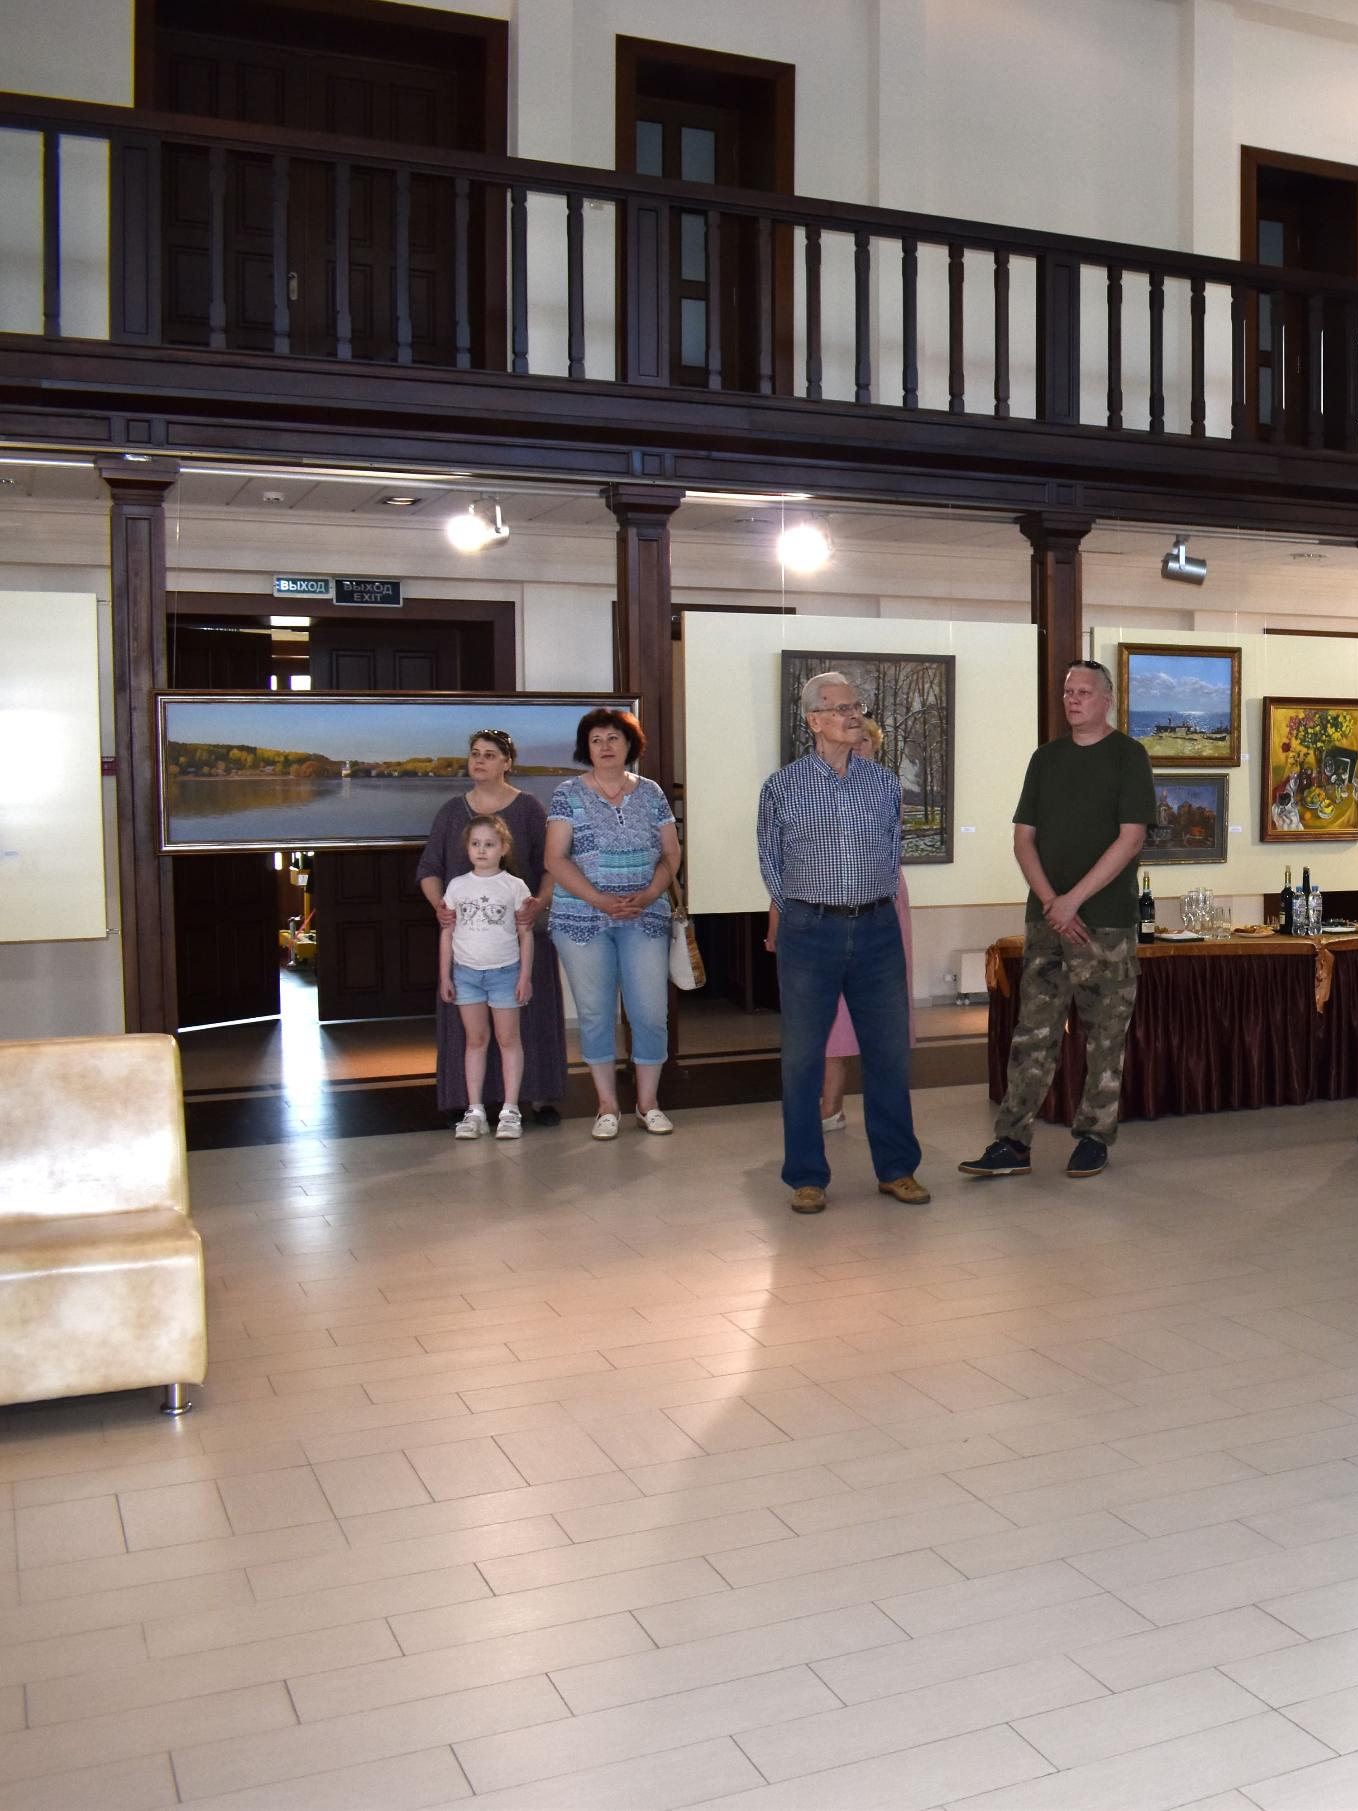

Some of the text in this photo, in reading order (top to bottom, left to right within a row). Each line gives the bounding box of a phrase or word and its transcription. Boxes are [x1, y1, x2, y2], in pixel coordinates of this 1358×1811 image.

[280, 580, 326, 593] ВЫХОД
[343, 582, 393, 595] ВЫХОД
[353, 593, 383, 602] EXIT
